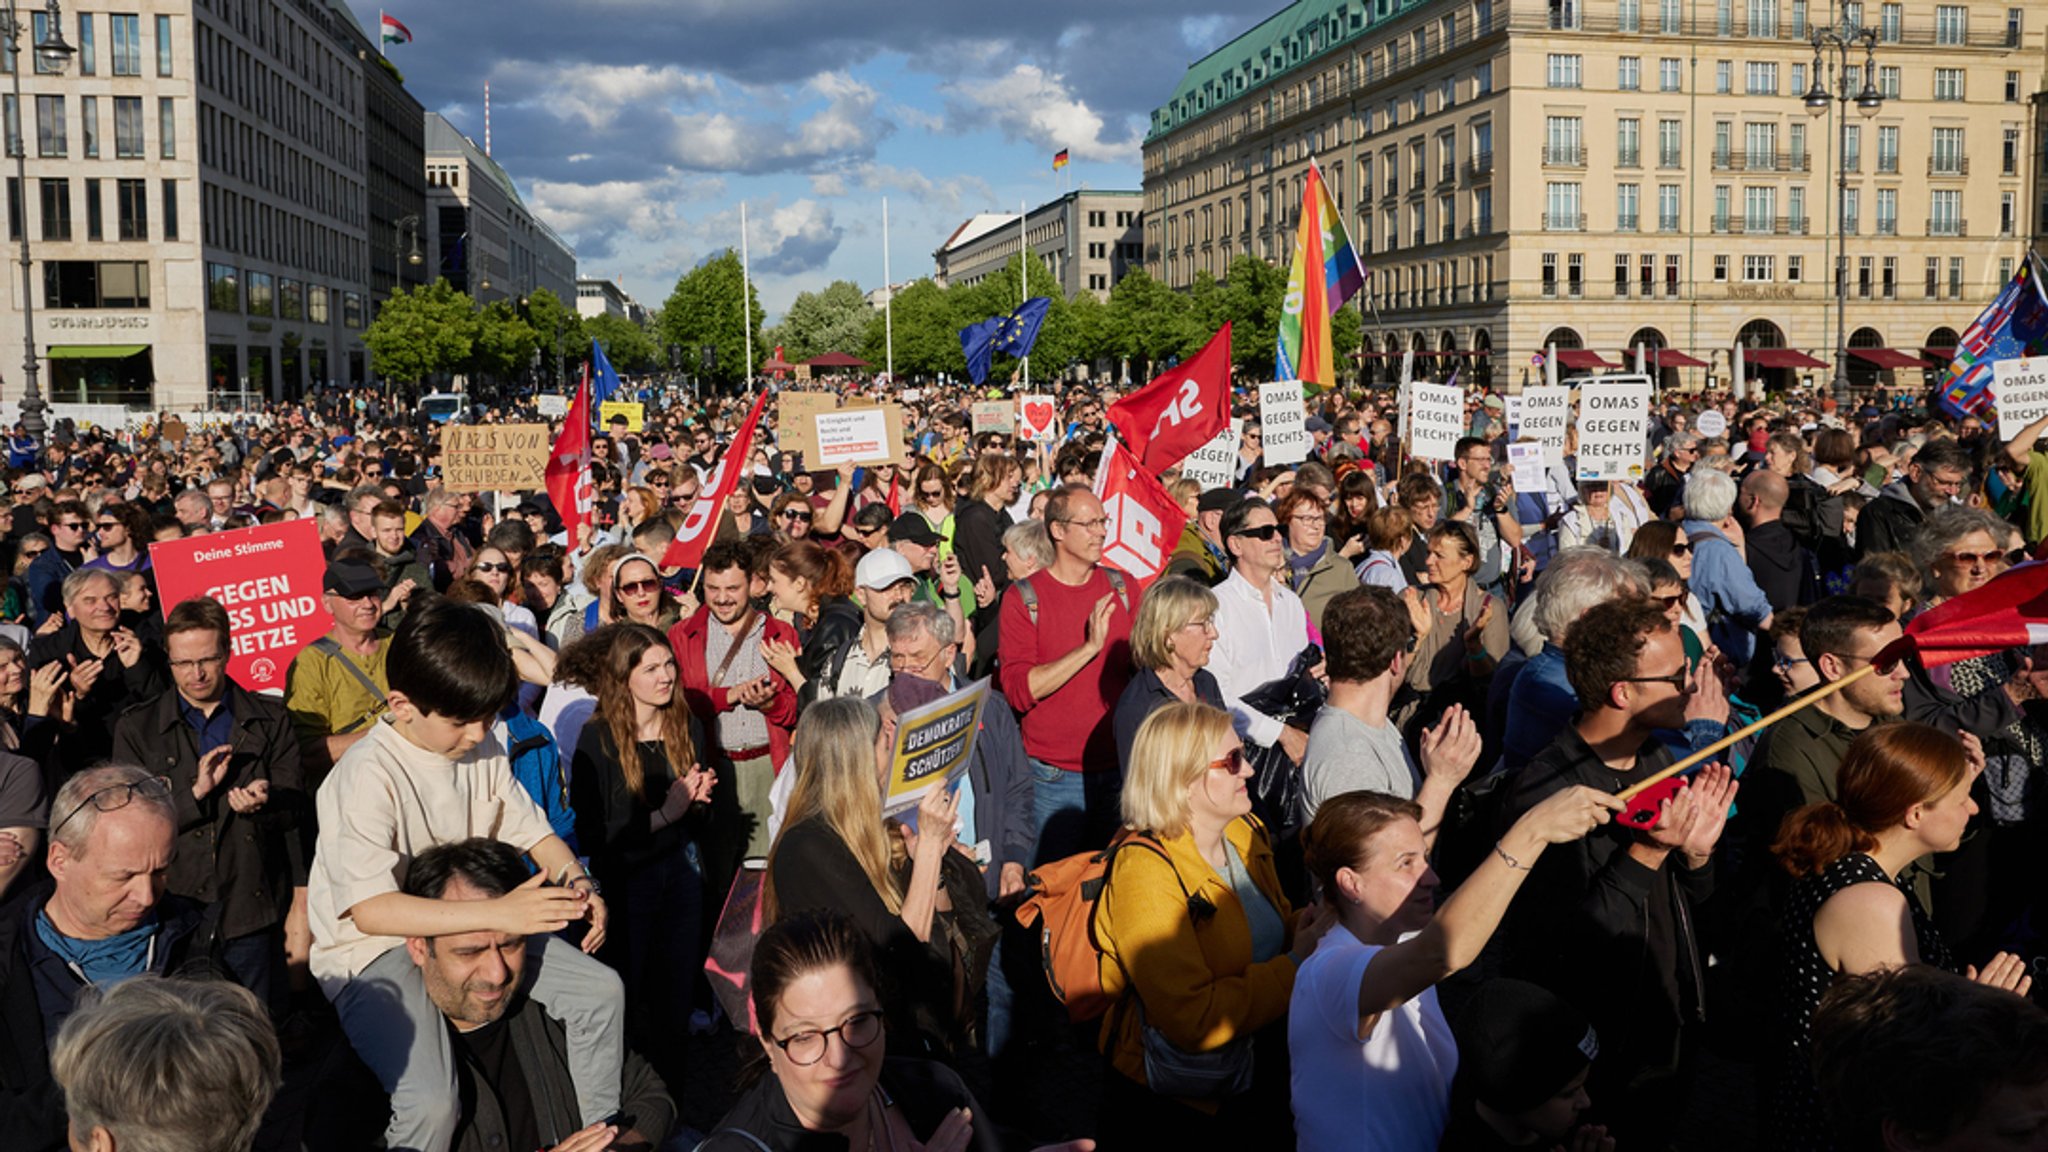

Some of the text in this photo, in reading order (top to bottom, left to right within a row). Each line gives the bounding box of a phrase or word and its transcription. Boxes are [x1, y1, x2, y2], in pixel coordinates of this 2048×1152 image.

[2003, 374, 2046, 387] OMAS
[1266, 390, 1298, 405] OMAS
[1420, 391, 1457, 406] OMAS
[1527, 396, 1563, 408] OMAS
[1590, 396, 1639, 409] OMAS
[1265, 411, 1301, 425] GEGEN
[1416, 410, 1459, 424] GEGEN
[1524, 416, 1563, 428] GEGEN
[1585, 420, 1640, 432] GEGEN
[447, 430, 540, 450] NAZIS VON
[1219, 429, 1235, 441] AS
[1264, 431, 1304, 446] RECHTS
[1414, 428, 1460, 442] RECHTS
[1541, 437, 1563, 447] HTS
[1581, 443, 1642, 456] RECHTS
[449, 468, 520, 484] SCHUBSEN
[193, 539, 284, 563] Deine Stimme
[205, 574, 290, 607] GEGEN
[229, 596, 316, 631] SS UND
